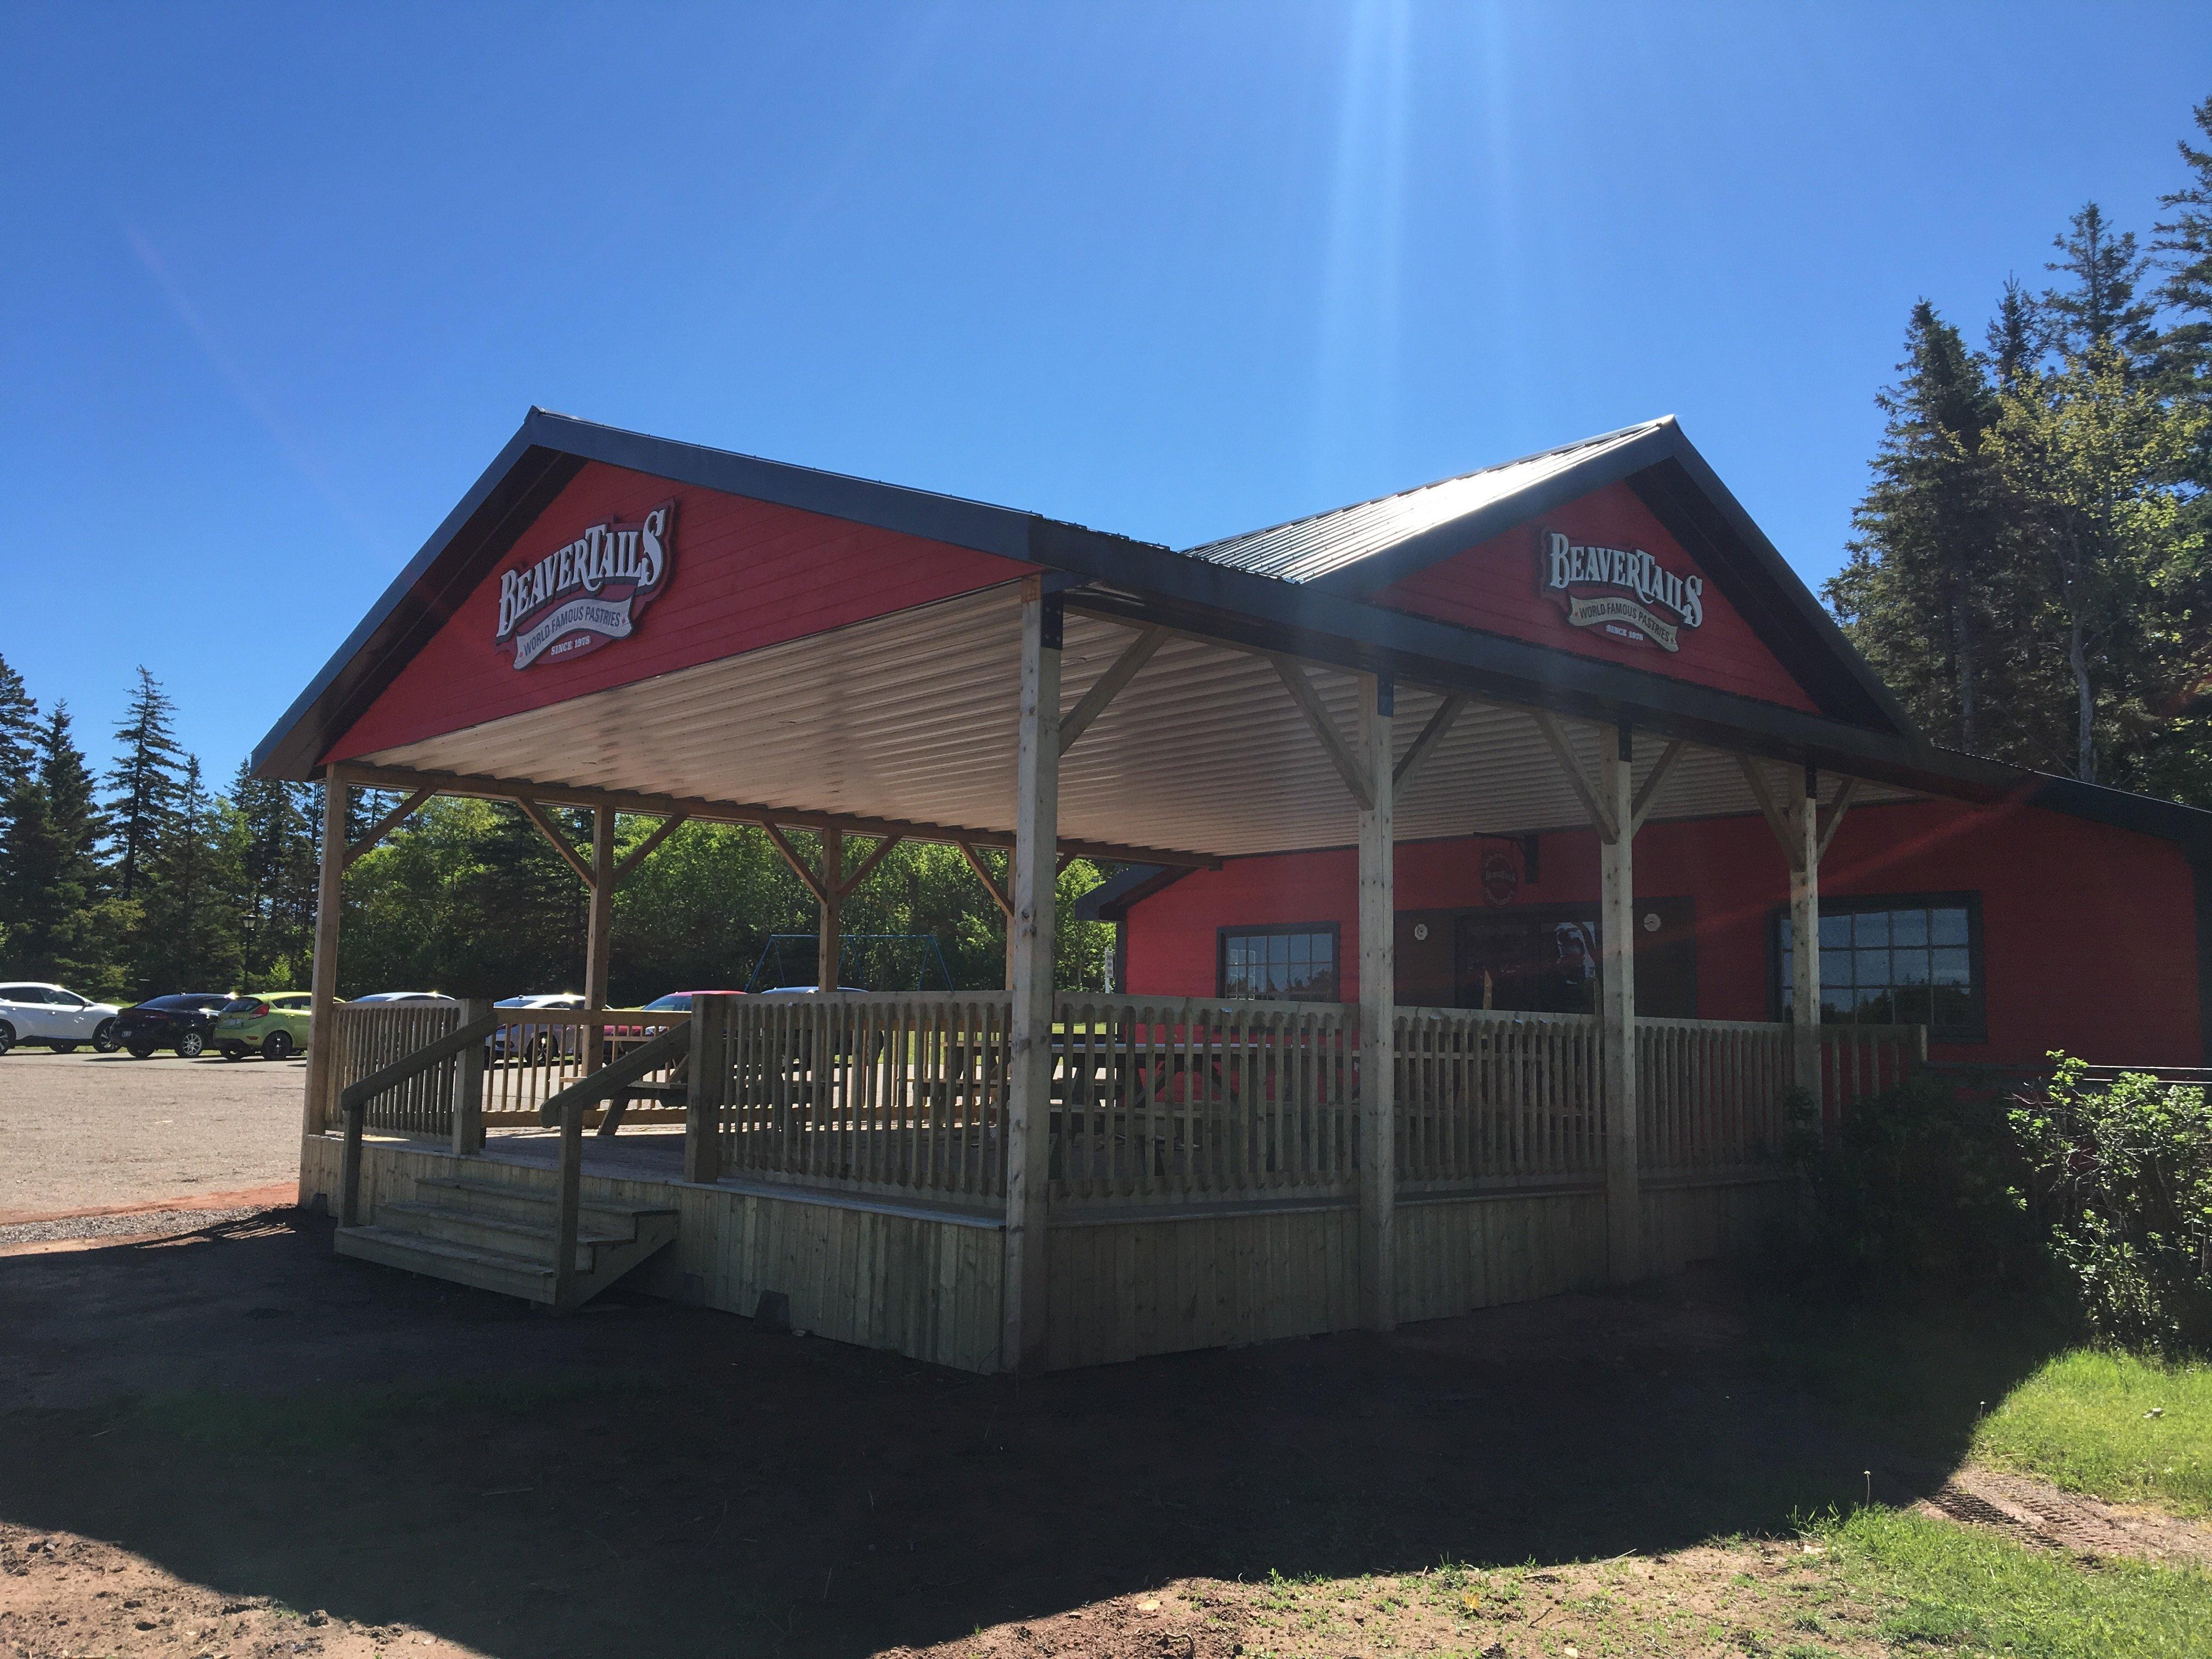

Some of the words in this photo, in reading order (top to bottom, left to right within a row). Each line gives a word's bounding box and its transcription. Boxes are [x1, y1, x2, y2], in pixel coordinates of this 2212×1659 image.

[524, 624, 550, 656] WORLD
[551, 606, 584, 633] FAMOUS
[585, 606, 620, 627] PASTRIES
[1580, 604, 1606, 619] WORLD
[1606, 602, 1637, 619] FAMOUS
[1638, 611, 1670, 642] PASTRIES
[551, 641, 573, 656] SINCE
[574, 635, 591, 648] 1978
